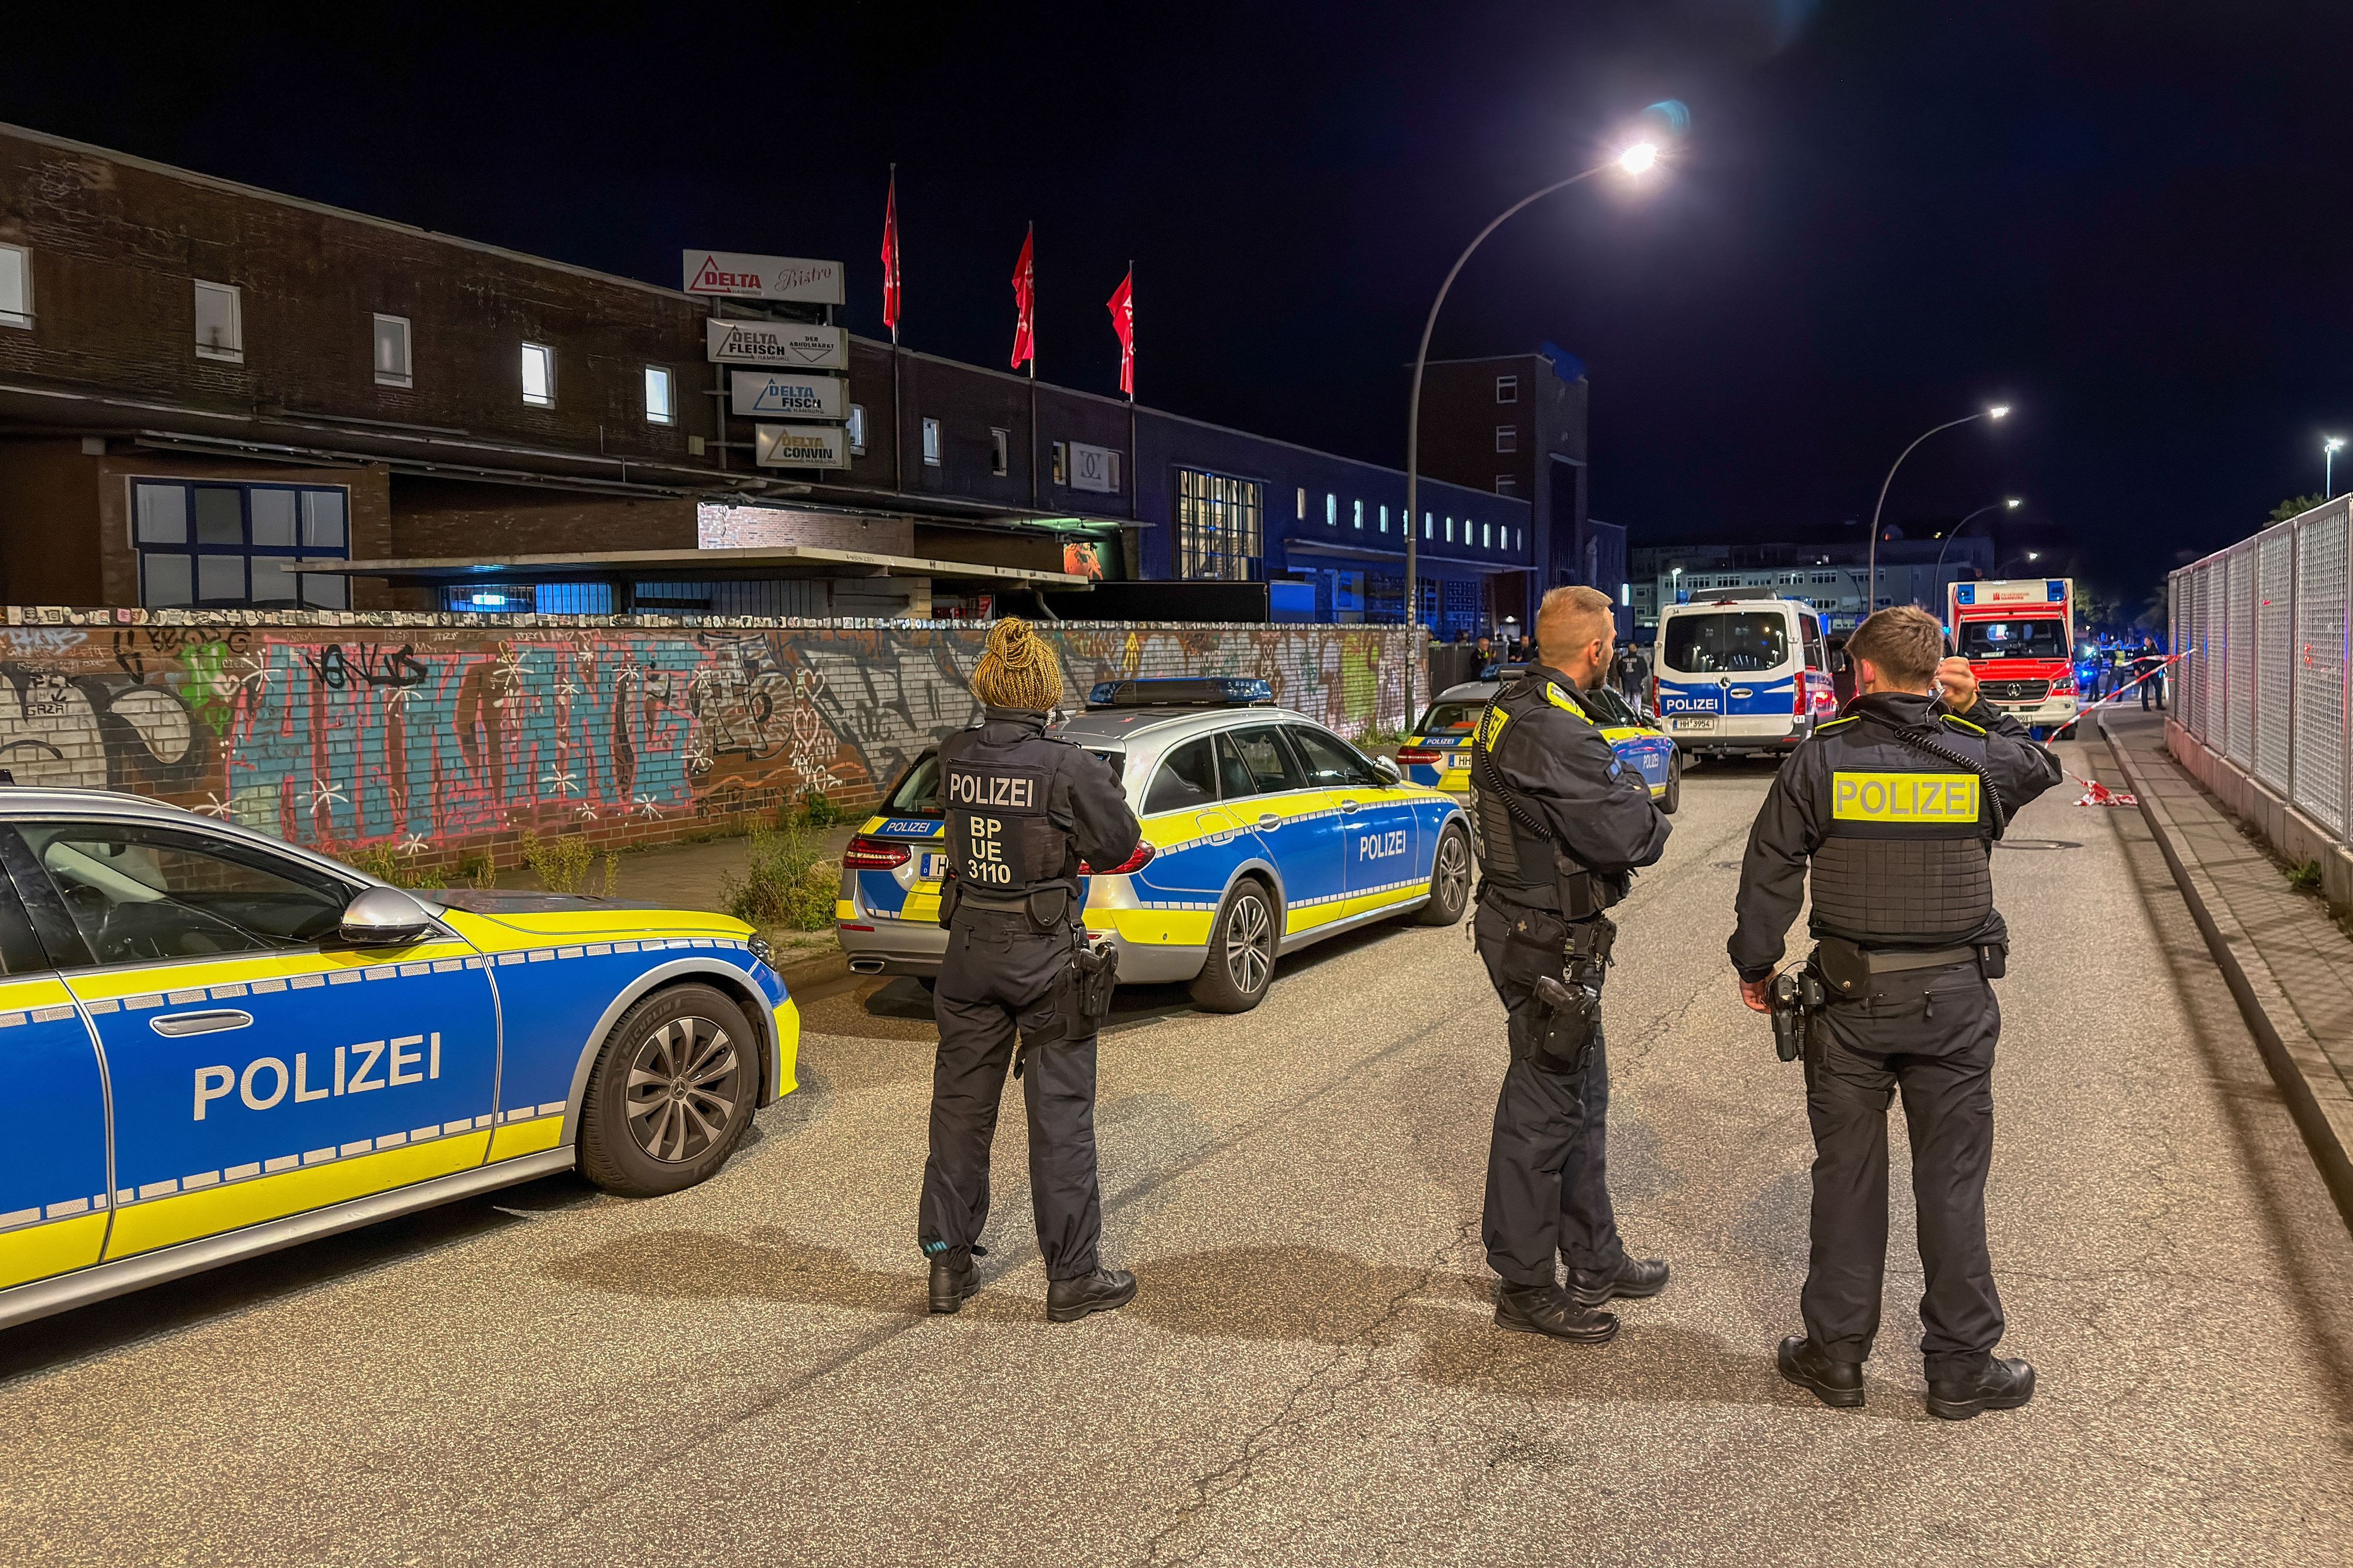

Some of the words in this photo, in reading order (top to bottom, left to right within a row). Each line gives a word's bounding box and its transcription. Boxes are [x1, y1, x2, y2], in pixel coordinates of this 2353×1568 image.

[705, 271, 761, 289] DELTA
[774, 266, 831, 292] Bistro
[732, 332, 778, 345] DELTA
[729, 343, 785, 356] FLEISCH
[769, 385, 815, 398] DELTA
[782, 398, 822, 409] FISCH
[781, 436, 824, 448] DELTA
[783, 447, 833, 459] CONVIN
[26, 703, 65, 716] GAZA
[1666, 698, 1718, 710] POLIZEI
[1692, 719, 1711, 728] 3954
[1643, 753, 1659, 769] POLIZEI
[950, 773, 1034, 808] POLIZEI
[1837, 780, 1975, 815] POLIZEI
[886, 822, 931, 833] POLIZEI
[970, 816, 1001, 839] BP
[971, 838, 1002, 862] UE
[1359, 830, 1405, 861] POLIZEI
[968, 859, 1011, 884] 3110
[193, 1030, 441, 1122] POLIZEI
